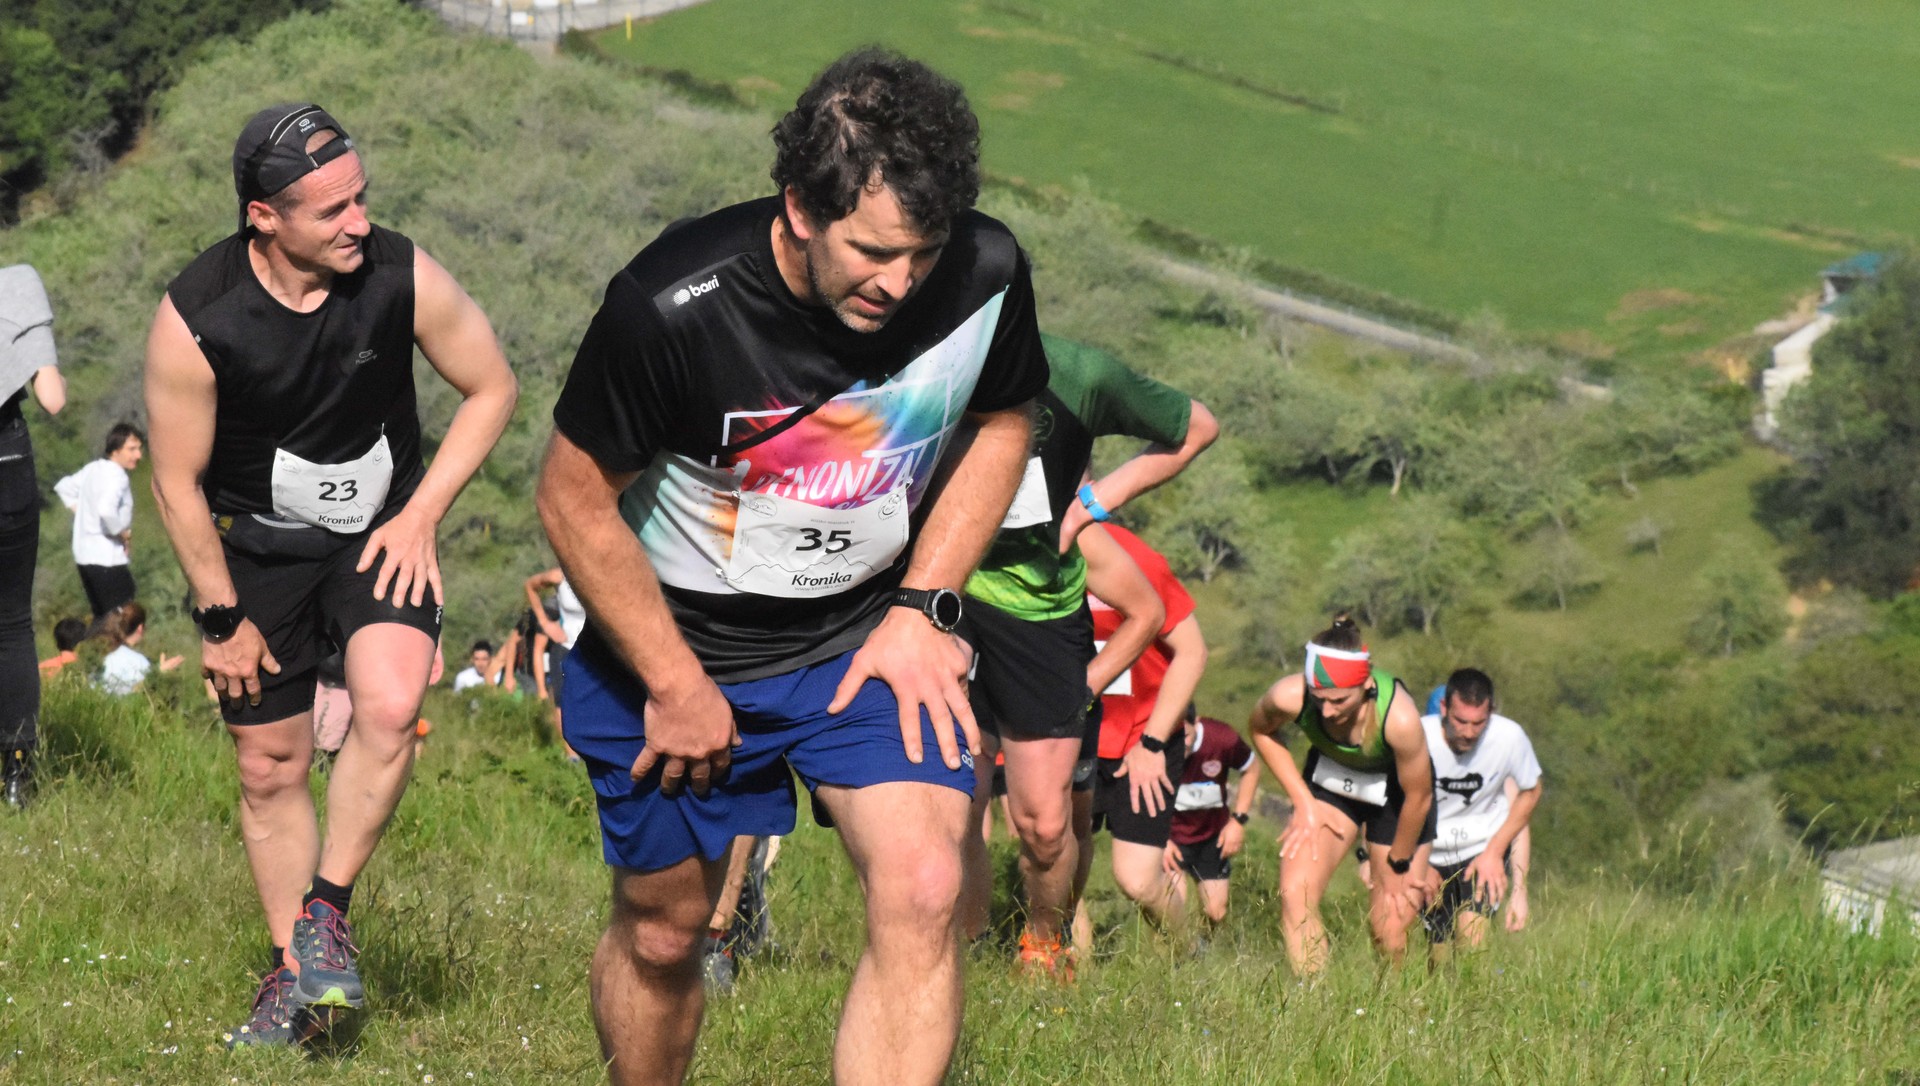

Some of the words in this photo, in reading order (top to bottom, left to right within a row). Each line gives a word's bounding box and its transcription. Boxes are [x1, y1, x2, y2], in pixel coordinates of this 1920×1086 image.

[688, 275, 719, 297] barri
[318, 479, 358, 502] 23
[318, 515, 364, 525] Kronika
[795, 527, 852, 554] 35
[791, 572, 852, 586] Kronika
[1343, 777, 1354, 793] 8
[1450, 827, 1469, 841] 96
